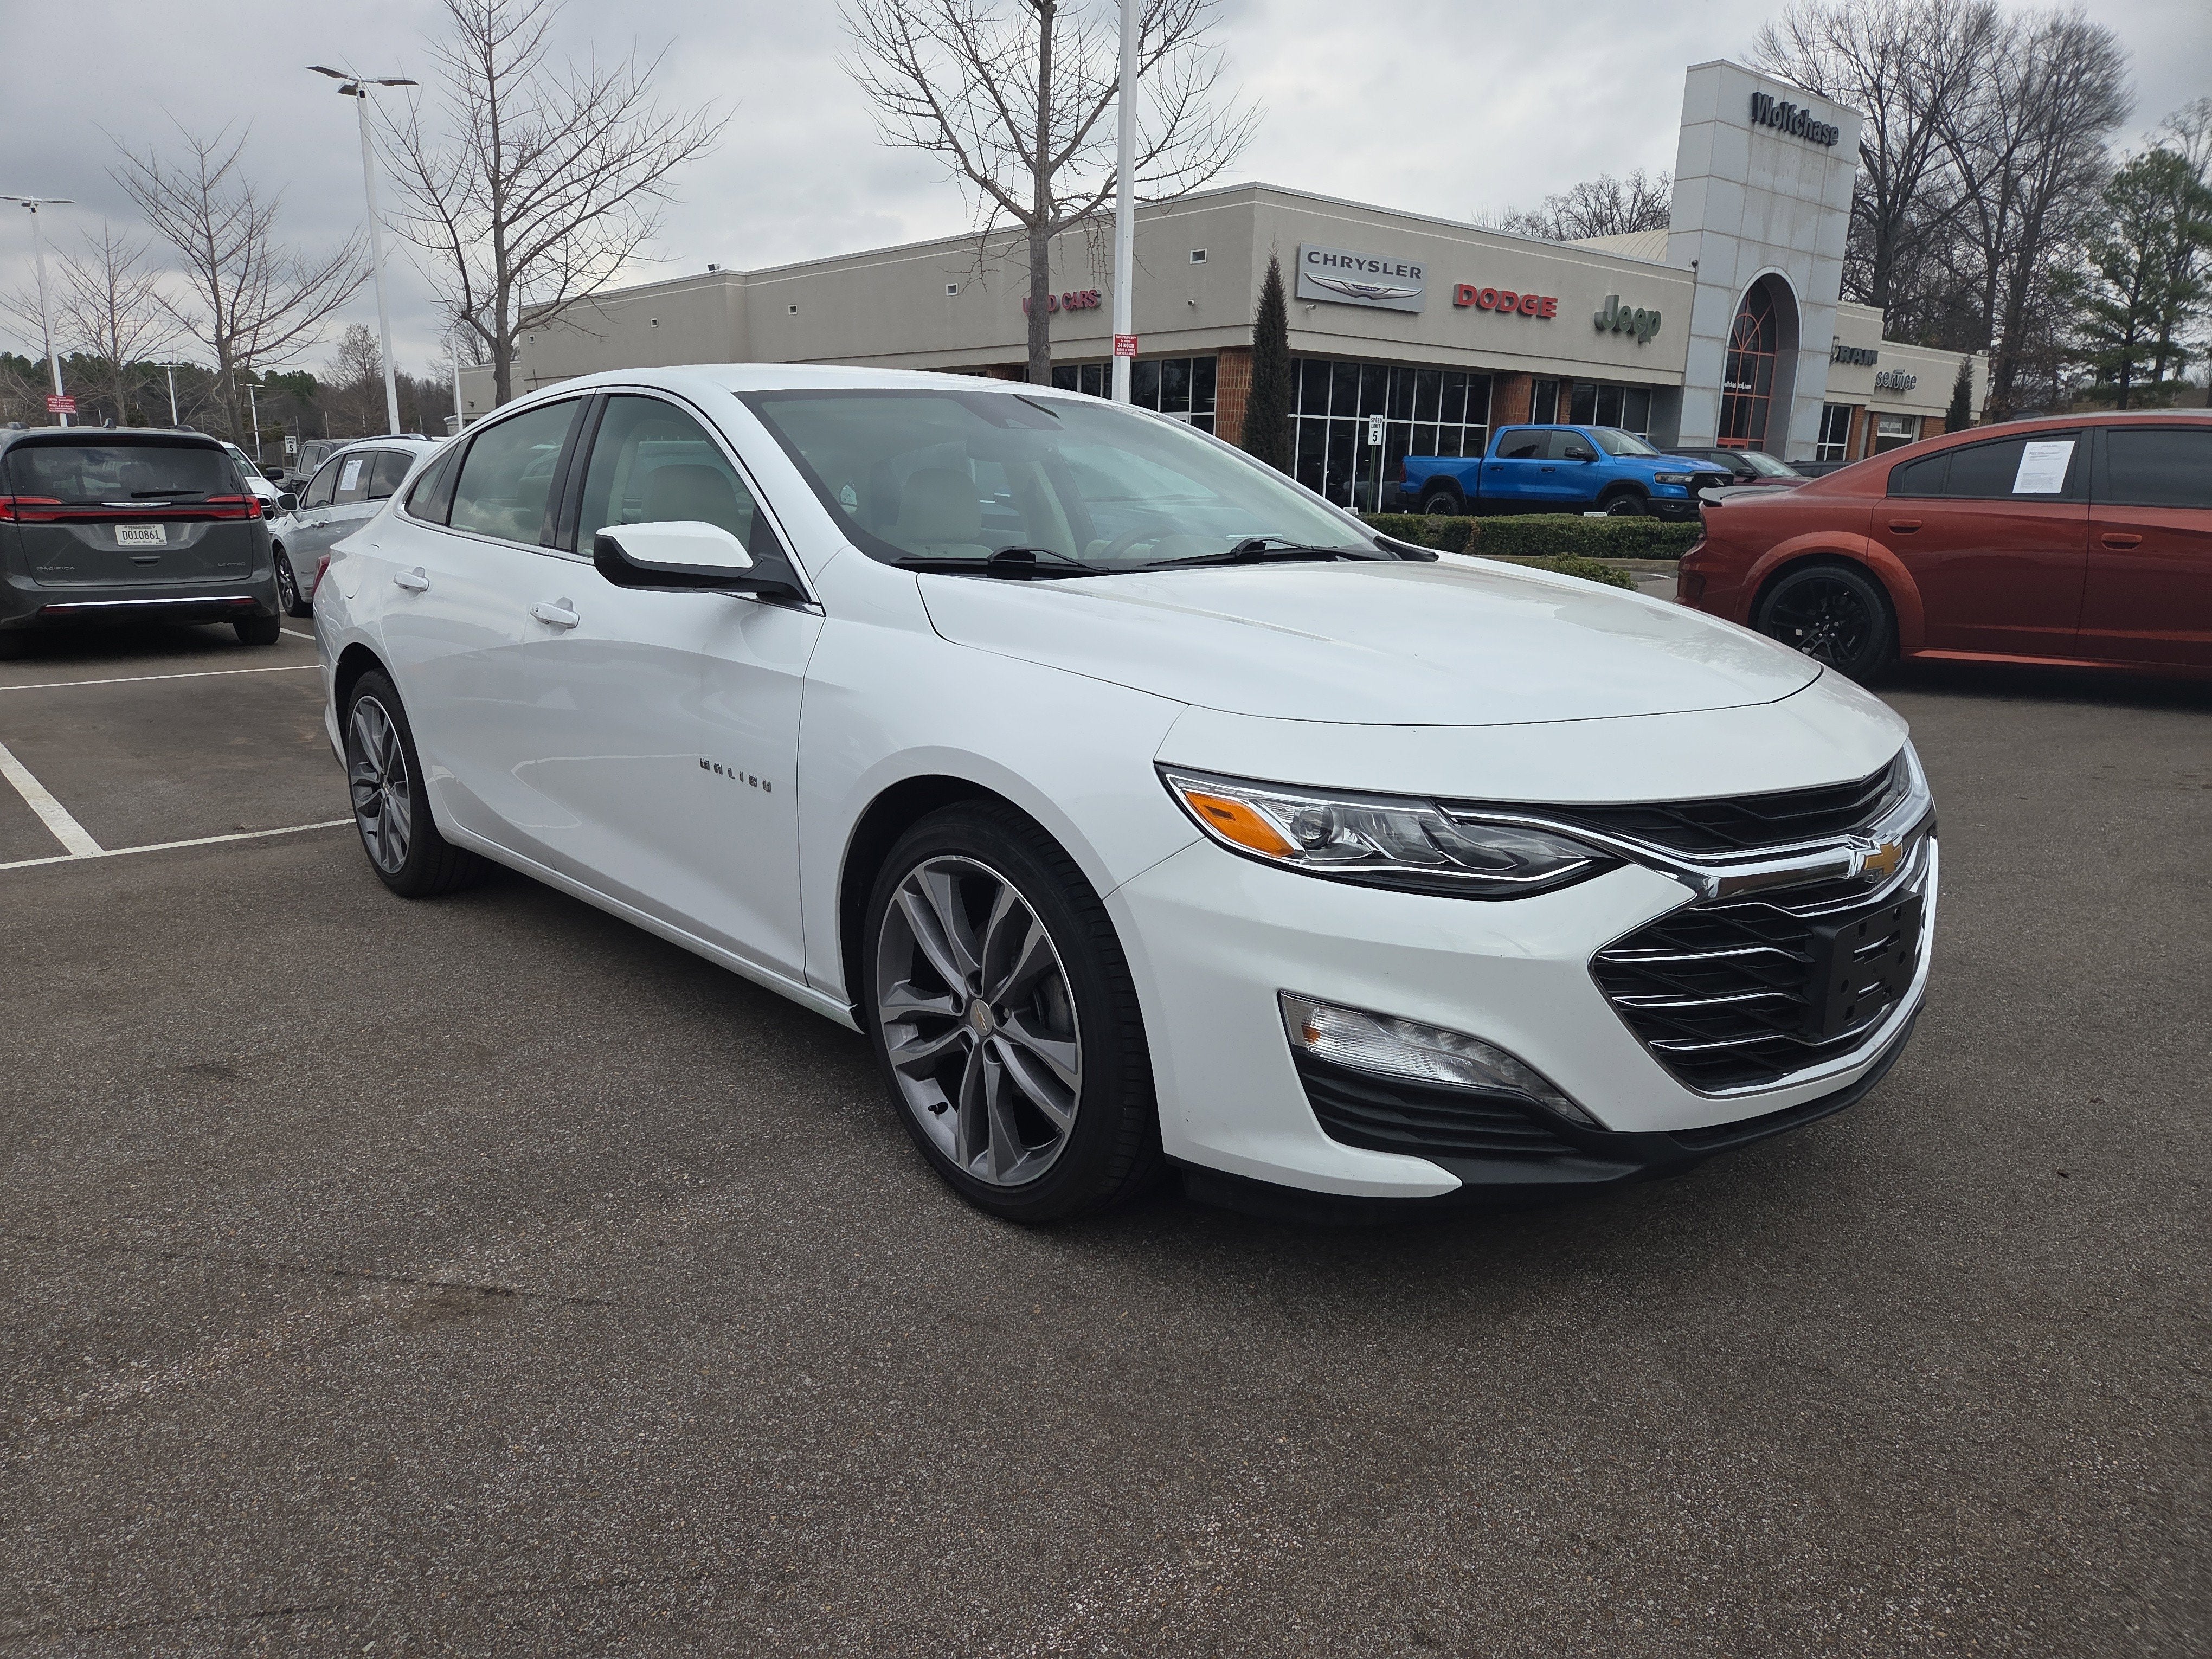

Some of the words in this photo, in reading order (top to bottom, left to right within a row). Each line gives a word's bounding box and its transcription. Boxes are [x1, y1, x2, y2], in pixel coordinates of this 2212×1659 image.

[1752, 92, 1839, 146] Wolfchase
[1307, 251, 1422, 279] CHRYSLER
[1023, 294, 1060, 314] UD
[1062, 290, 1102, 310] CARS
[1454, 284, 1558, 318] DODGE
[1594, 294, 1662, 344] Jeep
[1838, 345, 1879, 366] RAM
[1876, 369, 1917, 390] service
[1373, 431, 1378, 442] 5
[699, 758, 771, 793] MALIBU
